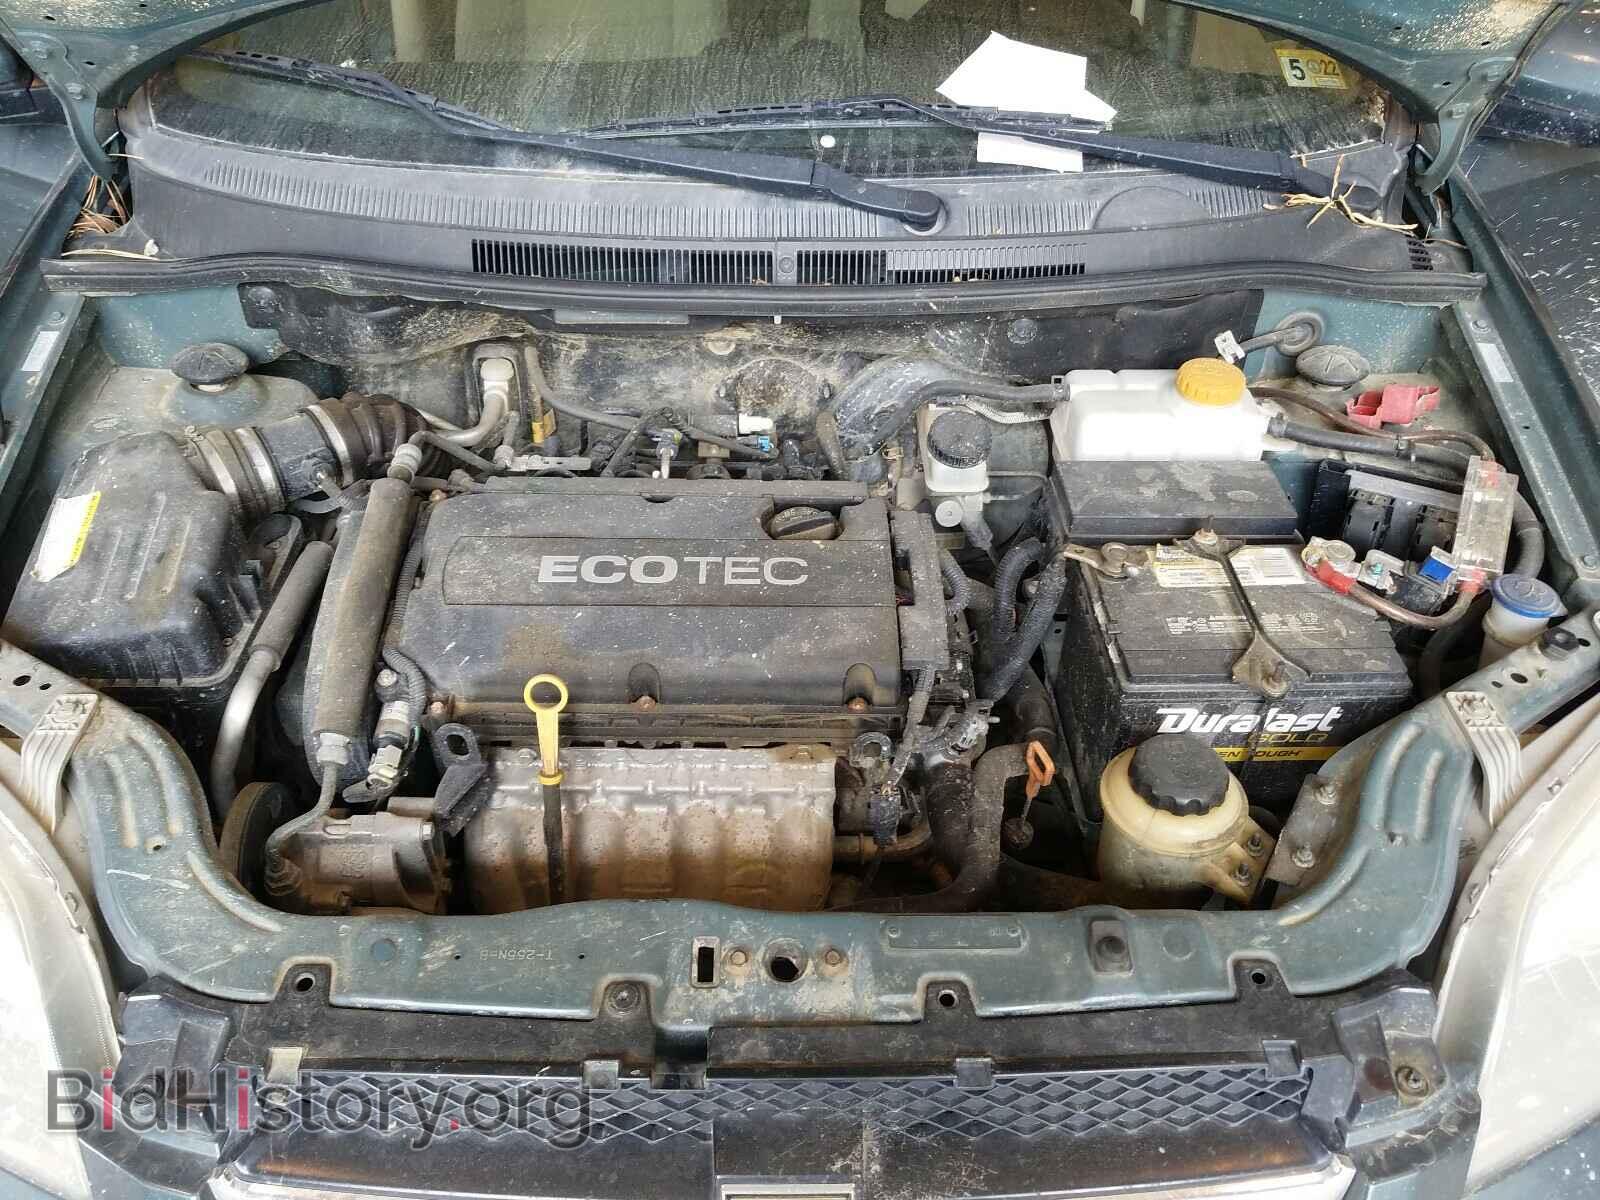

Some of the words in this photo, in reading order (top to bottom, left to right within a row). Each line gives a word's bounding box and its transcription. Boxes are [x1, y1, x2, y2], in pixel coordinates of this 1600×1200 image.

[1288, 58, 1306, 81] 5
[537, 555, 809, 586] ECOTEC
[1253, 750, 1304, 758] OUGH
